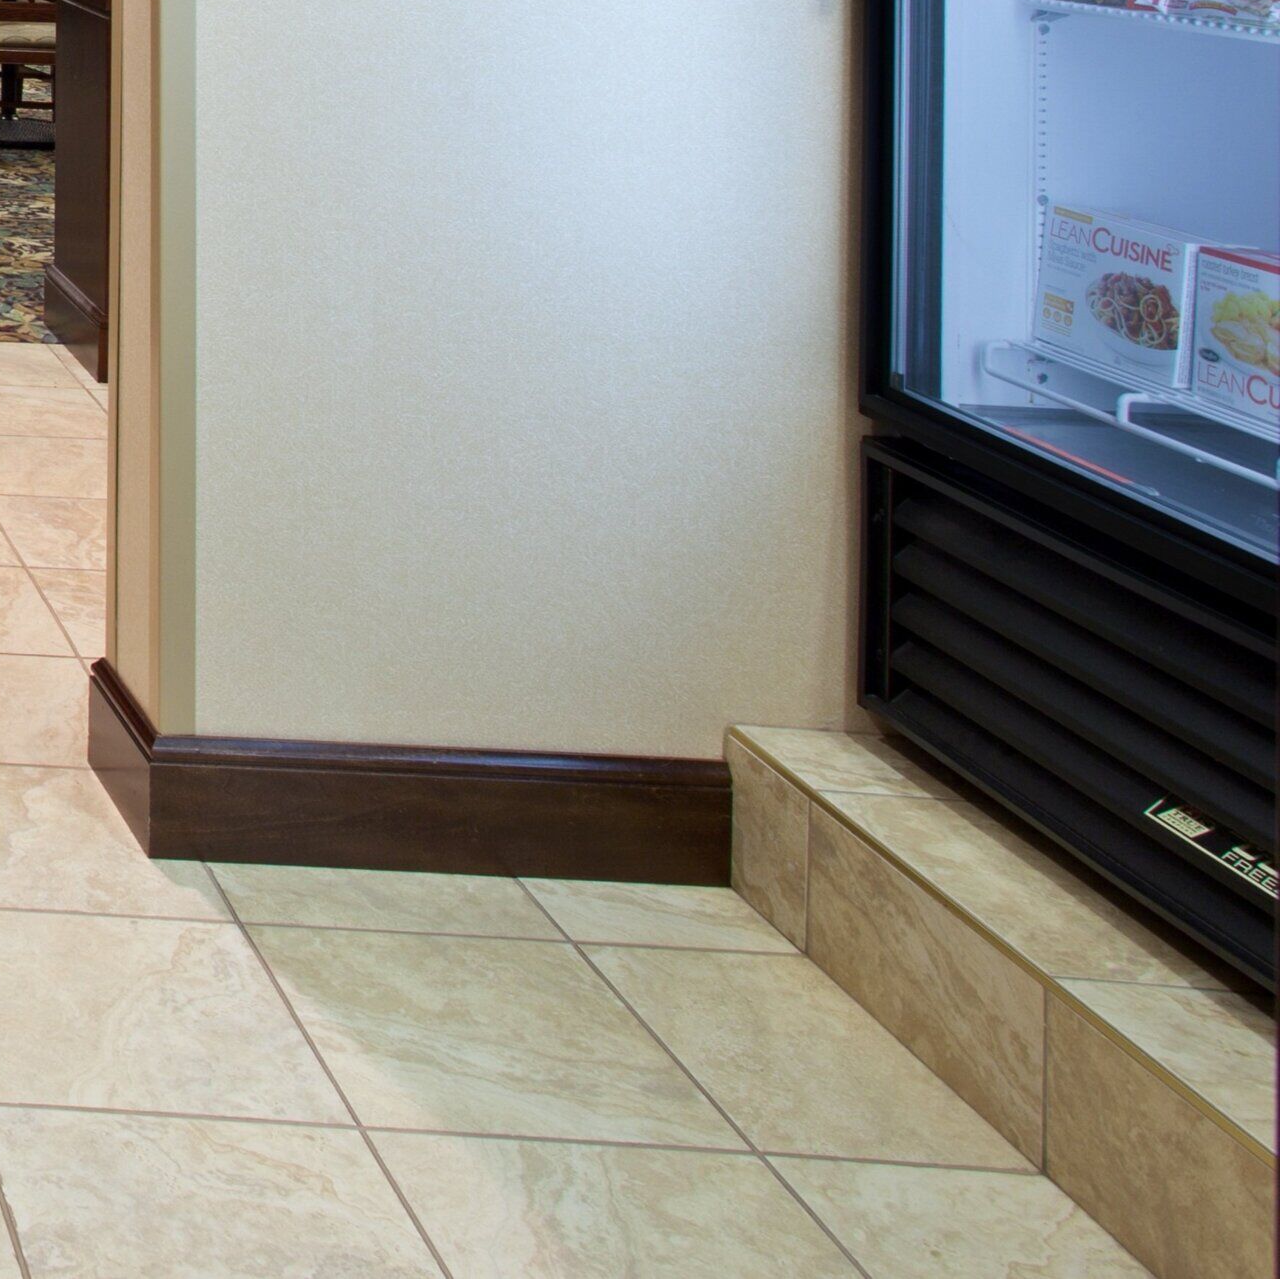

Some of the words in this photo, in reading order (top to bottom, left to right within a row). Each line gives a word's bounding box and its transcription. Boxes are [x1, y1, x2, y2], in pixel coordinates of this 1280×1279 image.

[1050, 218, 1092, 248] LEAN
[1092, 227, 1173, 272] CUISINE
[1197, 361, 1246, 398] LEAN
